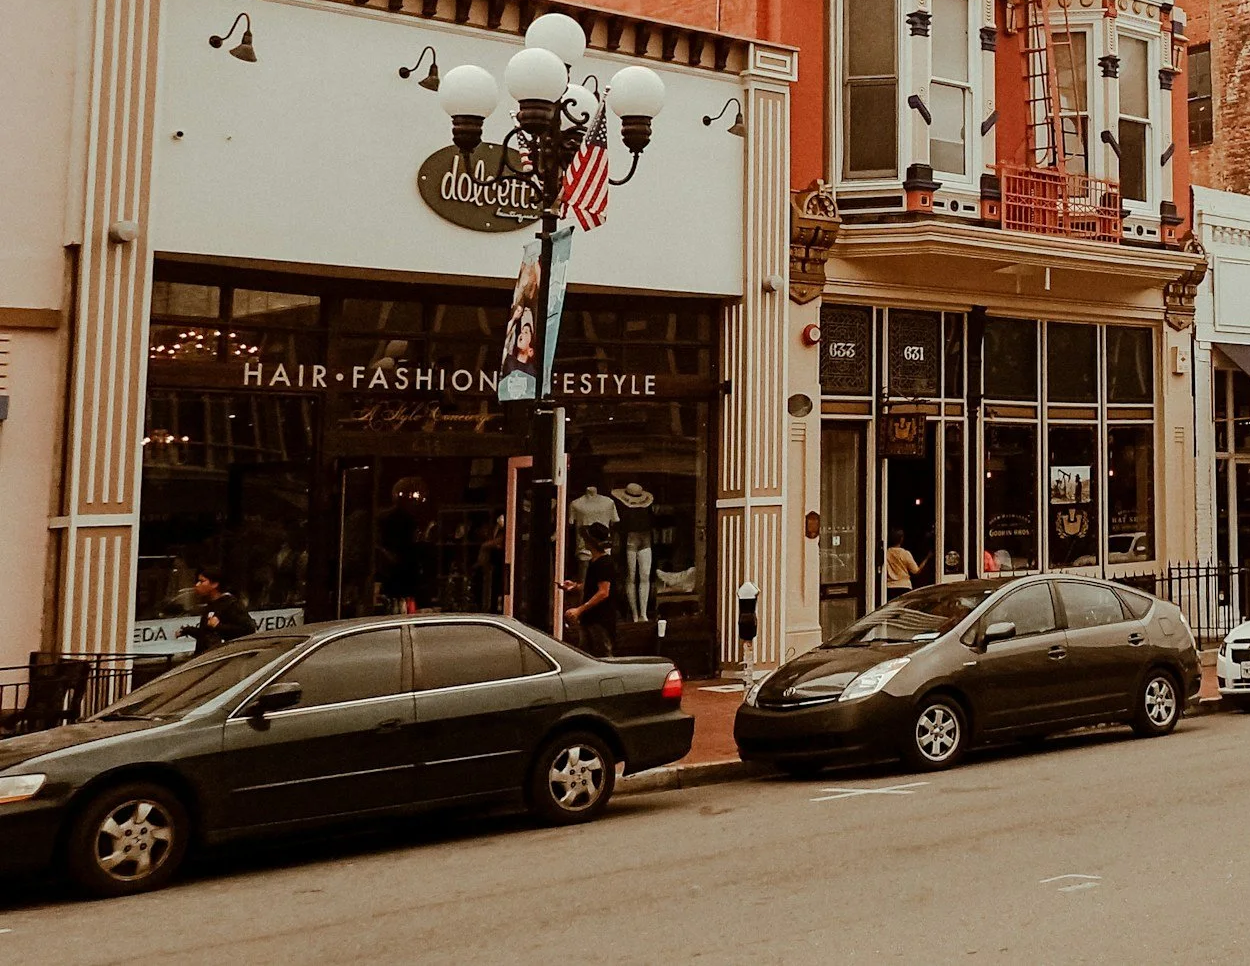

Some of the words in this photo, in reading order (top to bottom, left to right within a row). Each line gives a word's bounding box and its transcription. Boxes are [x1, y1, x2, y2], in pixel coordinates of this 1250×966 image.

[829, 342, 856, 357] 633
[903, 345, 925, 361] 631
[243, 362, 328, 388] HAIR
[352, 366, 498, 392] FASHION
[554, 372, 656, 395] ESTYLE
[254, 615, 297, 632] VEDA
